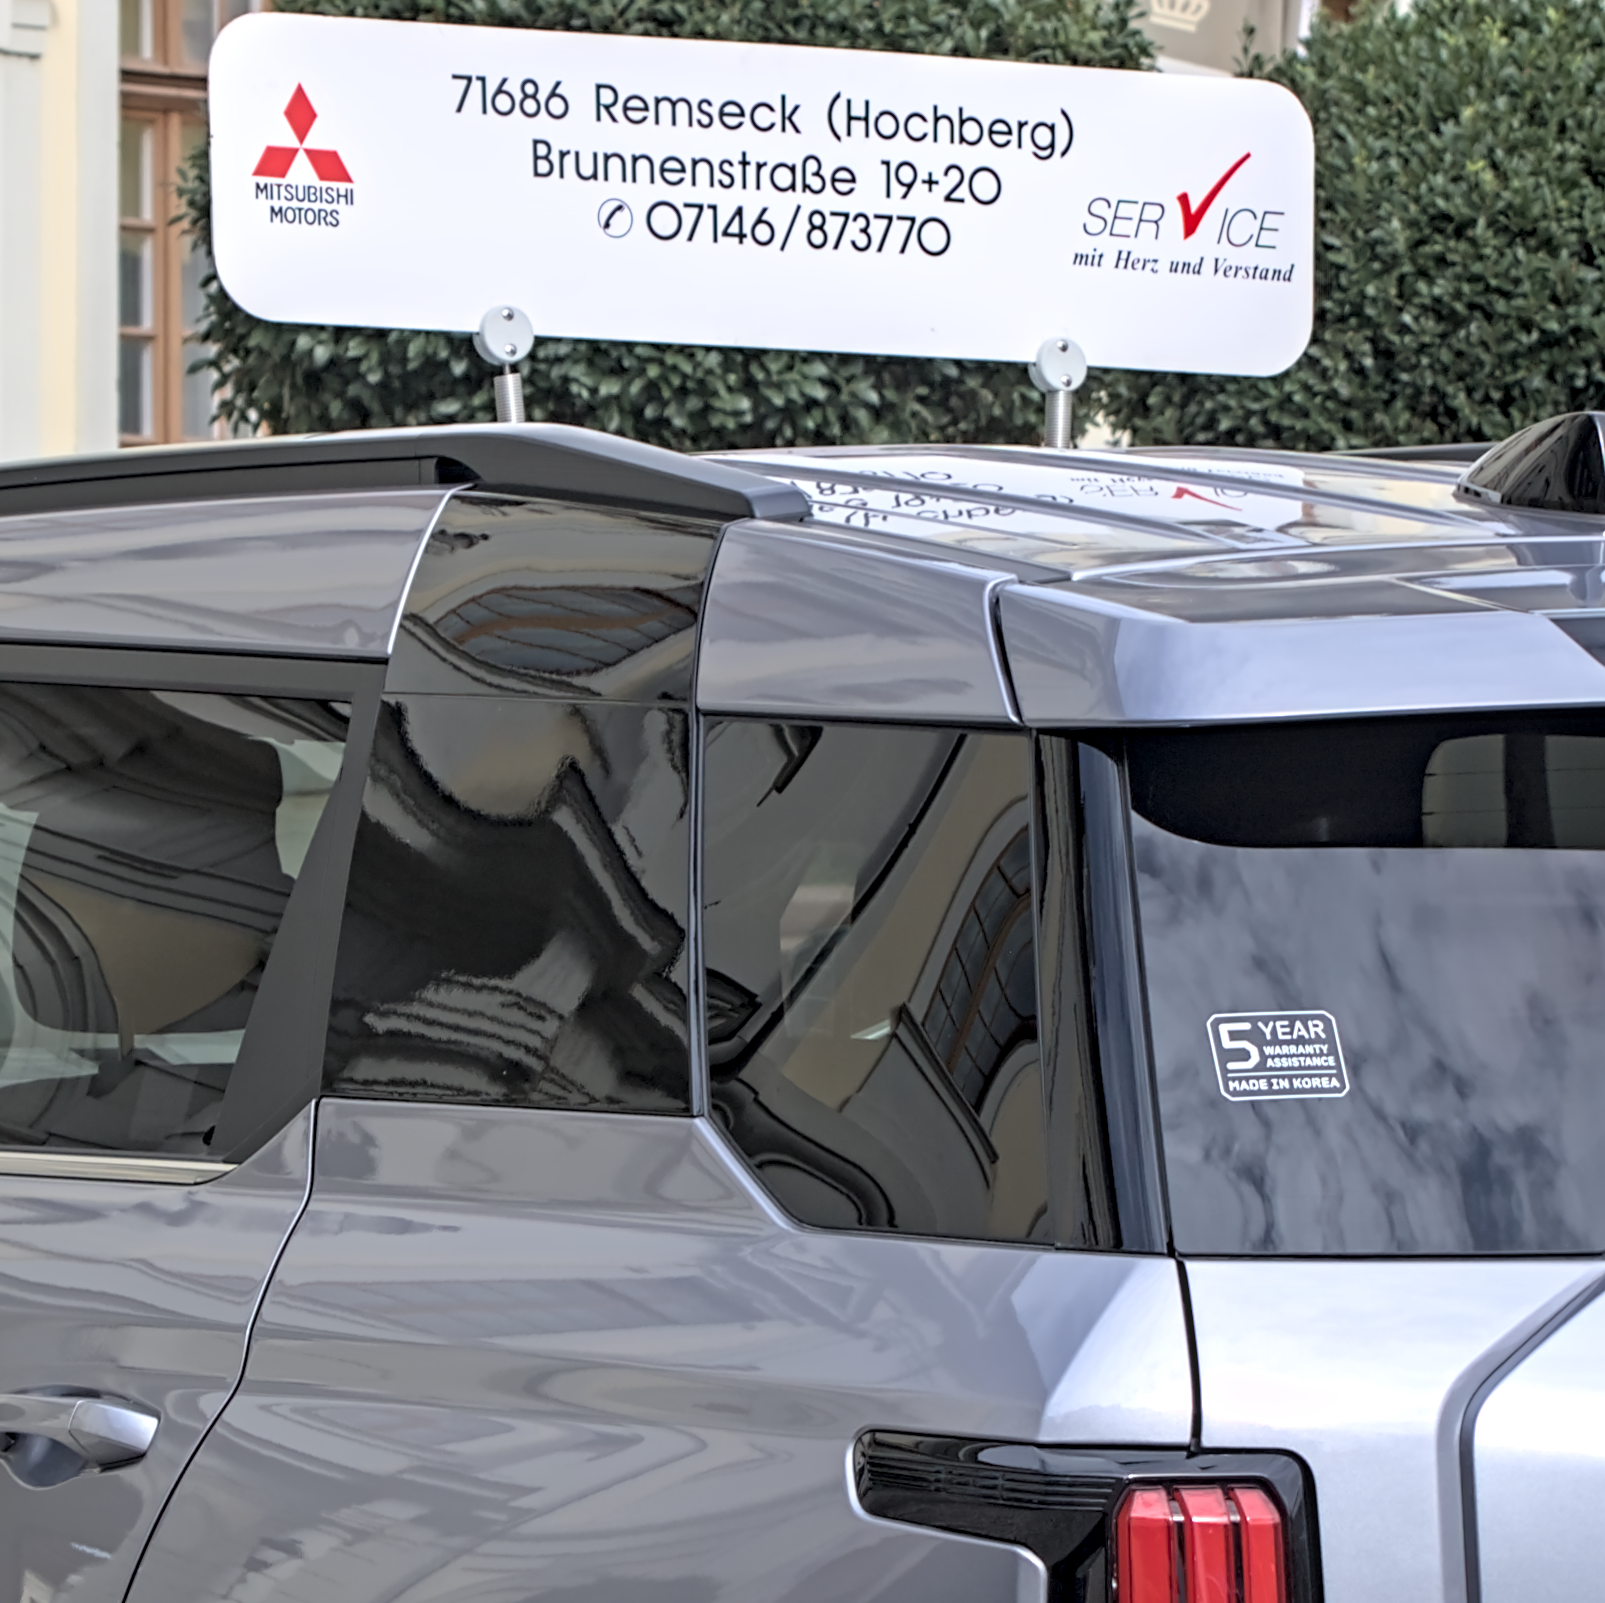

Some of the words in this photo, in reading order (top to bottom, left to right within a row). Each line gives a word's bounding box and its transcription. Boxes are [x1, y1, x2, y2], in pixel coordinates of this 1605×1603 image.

[451, 73, 570, 121] 71686
[594, 82, 802, 134] Remseck
[827, 90, 1074, 161] (Hochberg)
[531, 137, 857, 197] Brunnenstraße
[880, 158, 1002, 206] 19+20
[254, 181, 355, 206] MITSUBISHI
[269, 205, 340, 228] MOTORS
[645, 199, 951, 257] 07146/873770
[1072, 247, 1105, 269] mit
[1114, 249, 1160, 275] Herz
[1169, 256, 1205, 276] und
[1213, 257, 1296, 283] Verstand
[1218, 1021, 1261, 1071] 5
[1257, 1019, 1327, 1041] YEAR
[1263, 1044, 1329, 1056] WARRANTY
[1266, 1055, 1336, 1069] ASSISTANCE
[1227, 1078, 1269, 1092] MADE
[1271, 1077, 1290, 1090] IN
[1292, 1076, 1340, 1090] KOREA
